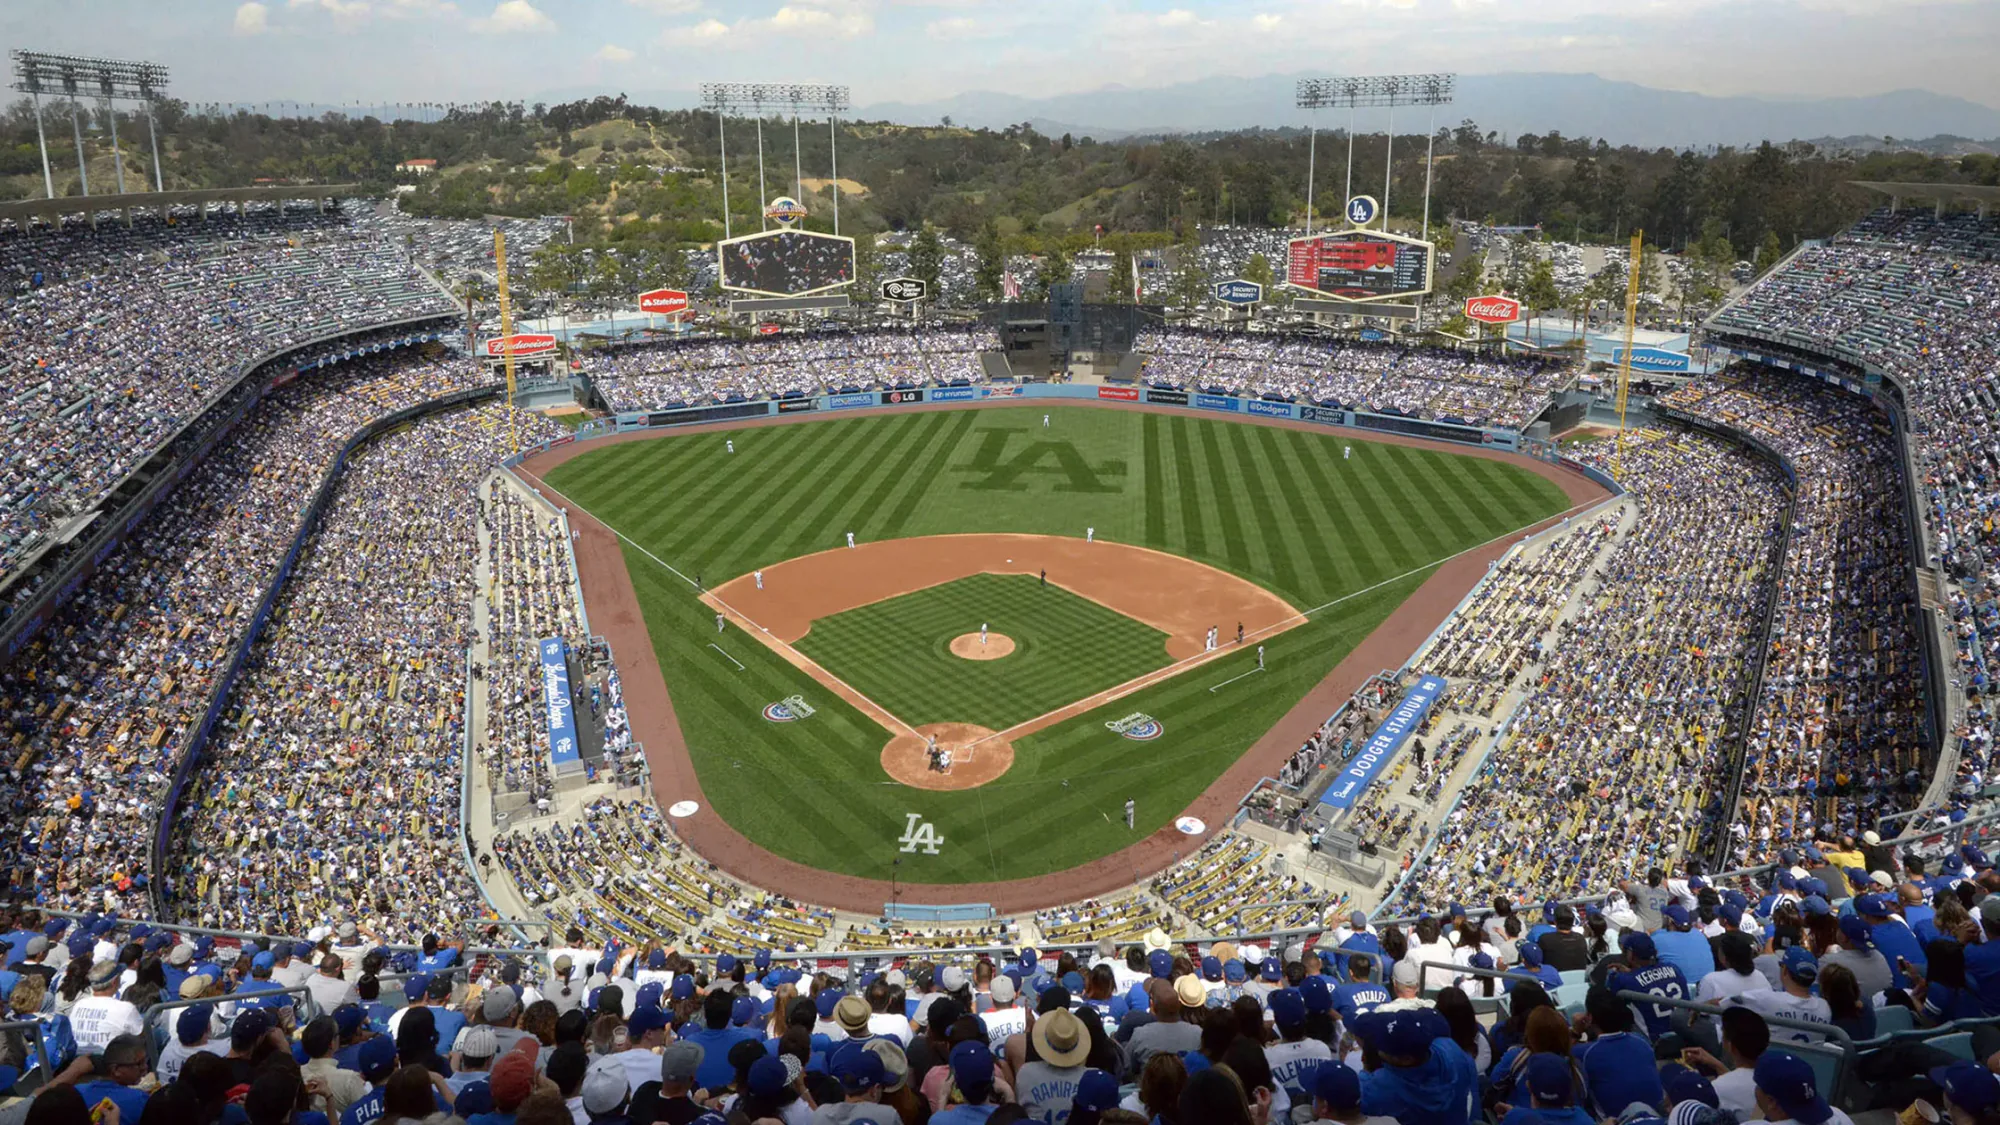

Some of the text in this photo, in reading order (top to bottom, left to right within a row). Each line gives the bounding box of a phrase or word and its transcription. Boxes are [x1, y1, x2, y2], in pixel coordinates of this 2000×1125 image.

[1353, 201, 1366, 220] LA
[1647, 356, 1685, 367] LIGHT
[903, 393, 915, 401] LG
[1249, 402, 1289, 415] @Dodgers
[1315, 408, 1342, 418] SECURITY
[1315, 415, 1340, 423] BENEFIT
[1666, 408, 1719, 429] SECURITY BENEFIT
[950, 427, 1128, 493] LA
[1350, 694, 1427, 778] DODGER STADIUM
[898, 812, 945, 855] LA
[1635, 966, 1677, 987] KERSHAW
[1352, 990, 1387, 1007] GONZALEZ
[76, 1008, 108, 1019] PITCHING
[77, 1020, 99, 1032] IN THE
[75, 1032, 111, 1043] MMUNITY
[1272, 1058, 1325, 1084] LENZU
[355, 1098, 385, 1123] PIA
